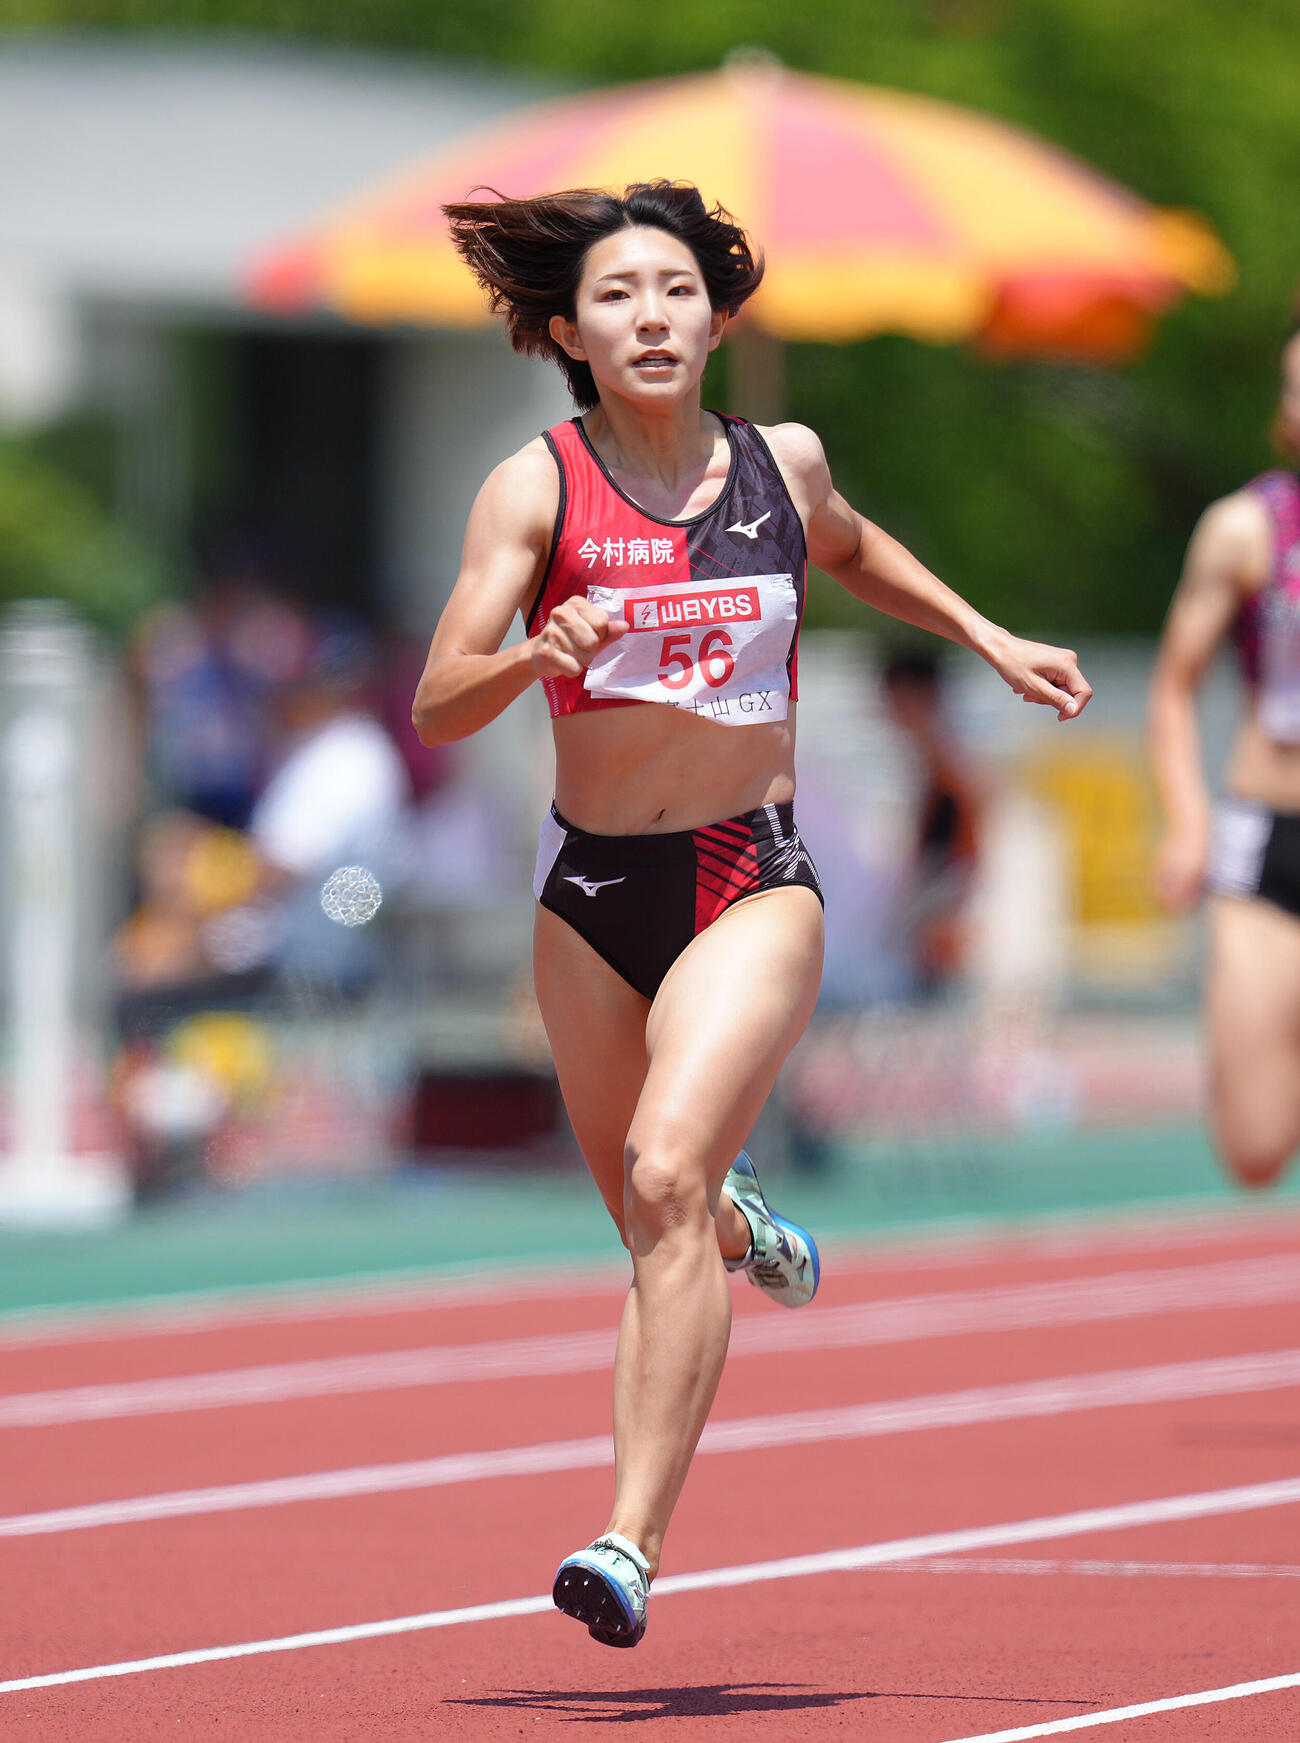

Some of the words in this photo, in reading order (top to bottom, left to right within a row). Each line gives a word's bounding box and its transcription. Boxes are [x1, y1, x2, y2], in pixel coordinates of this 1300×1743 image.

[578, 537, 675, 568] 今村病院
[661, 594, 753, 623] 山日YBS
[657, 629, 735, 690] 56
[662, 695, 730, 718] 士山
[738, 690, 774, 713] GX
